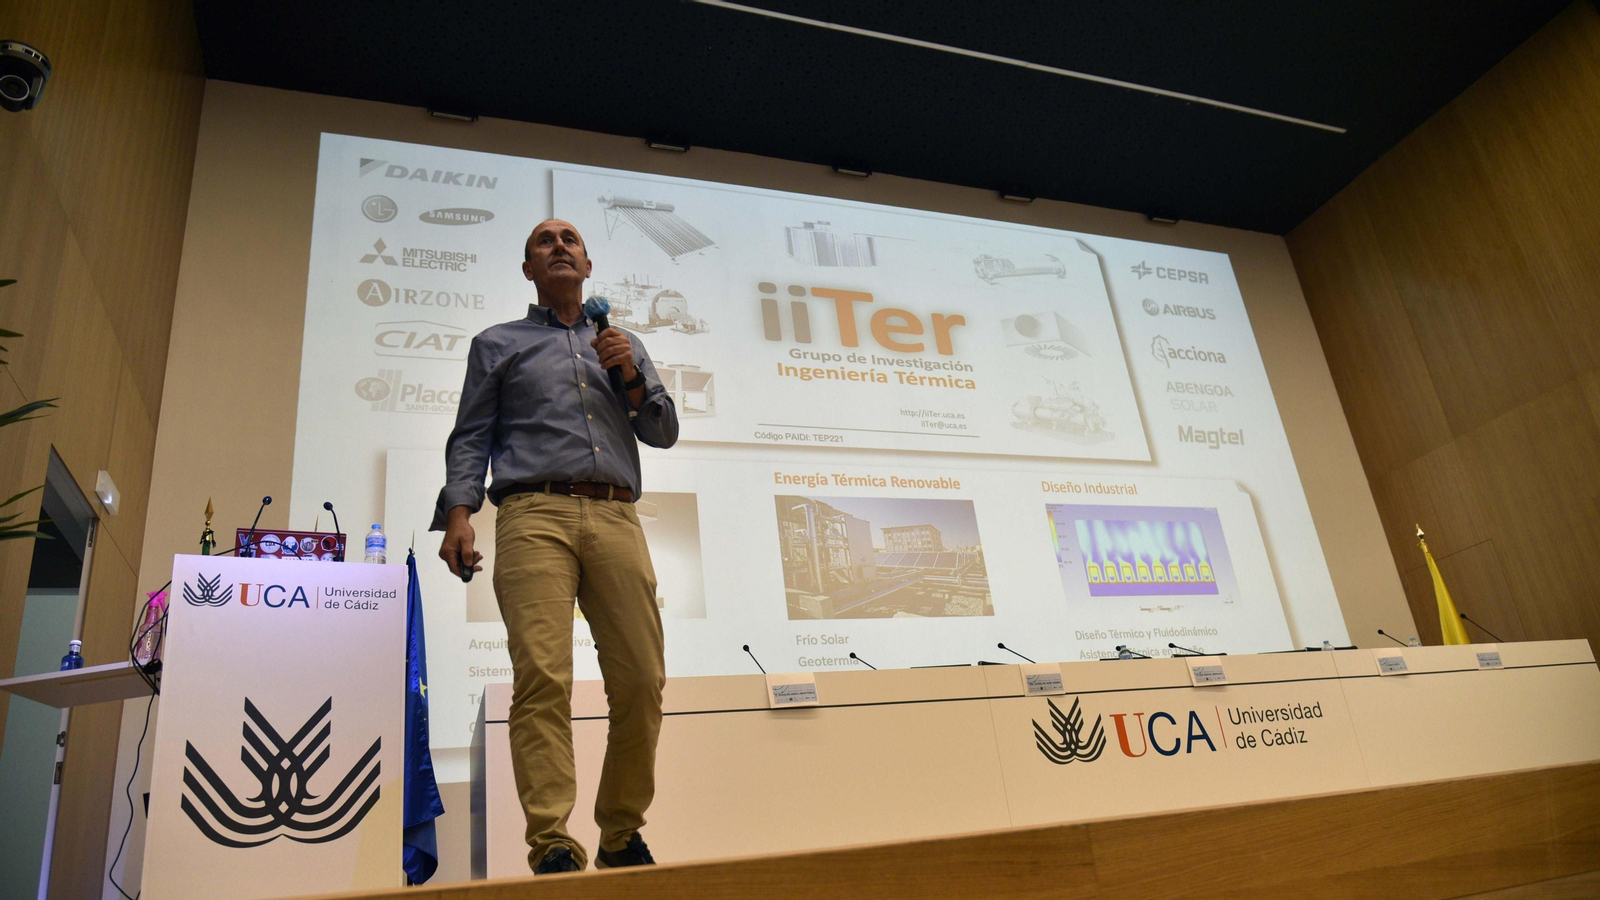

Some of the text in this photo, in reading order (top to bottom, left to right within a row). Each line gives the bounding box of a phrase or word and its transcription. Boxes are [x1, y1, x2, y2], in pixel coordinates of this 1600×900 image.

[384, 164, 499, 190] DAIKIN
[428, 209, 486, 223] SAMSUNG
[402, 247, 477, 264] MITSUBISHI
[402, 257, 468, 272] ELECTRIC
[1156, 266, 1209, 285] CEPSA
[364, 281, 485, 310] AIRZONE
[757, 281, 967, 356] iiTer
[1163, 303, 1217, 320] AIRBUS
[375, 330, 467, 352] CIAT
[788, 348, 974, 373] Grupo de Investigación
[1167, 345, 1227, 364] acciona
[777, 362, 977, 390] Ingeniería Térmica
[400, 383, 463, 405] Placo
[1166, 380, 1234, 398] ABENGOA
[405, 403, 457, 413] SAINT-GOBA
[1170, 398, 1218, 413] SOLAR
[754, 431, 844, 443] Código PAIDI: TEP221
[1178, 424, 1245, 450] Magtel
[773, 471, 961, 490] Energía Térmica Renovable
[1041, 480, 1139, 496] Diseño Industrial
[238, 582, 311, 609] UCA
[324, 585, 398, 600] Universidad
[324, 599, 379, 611] de Cádiz
[795, 633, 850, 646] Frío Solar
[1074, 626, 1218, 641] Diseño Térmico y Fluidodinámico
[468, 637, 509, 651] Arquit
[1079, 648, 1118, 660] Asistenc
[1162, 649, 1173, 657] en
[468, 665, 515, 678] Sistem
[1227, 700, 1324, 726] Universidad
[1108, 709, 1218, 759] UCA
[1235, 726, 1309, 750] de Cádiz
